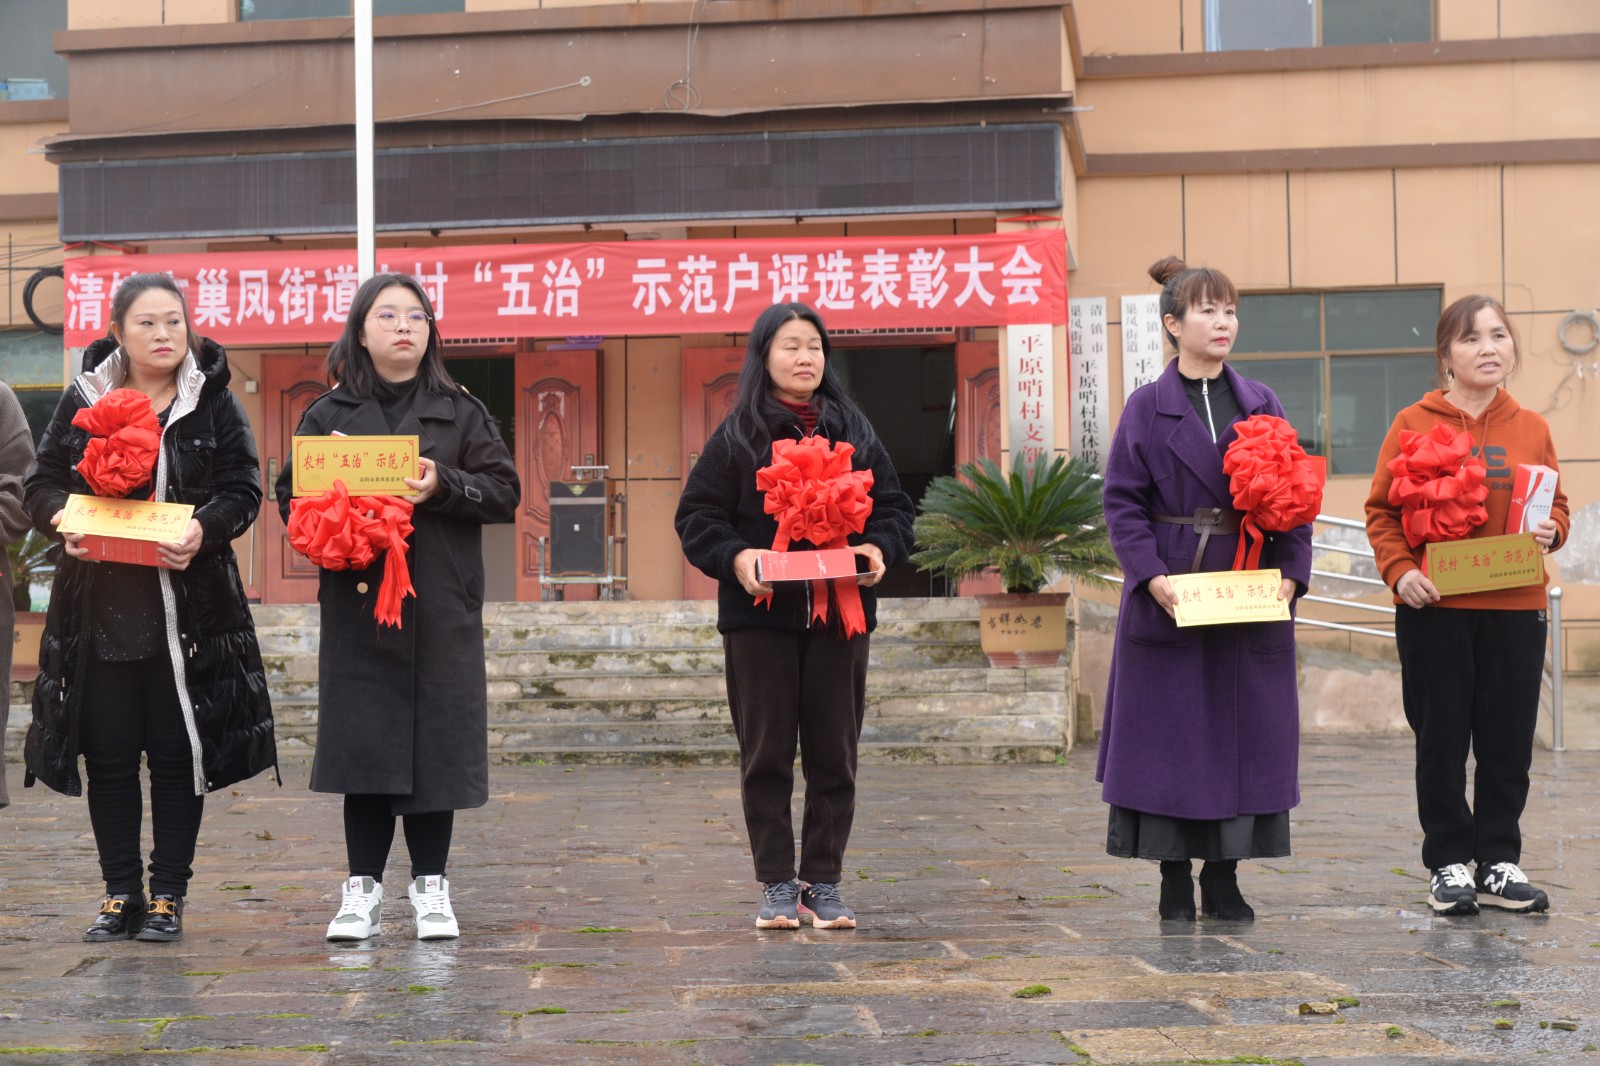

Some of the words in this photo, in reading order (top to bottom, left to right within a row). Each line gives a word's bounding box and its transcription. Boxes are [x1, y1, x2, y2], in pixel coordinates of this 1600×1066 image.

[66, 245, 1043, 330] 清巢凤街道村“五治”示范户评选表彰大会
[303, 452, 412, 470] 农村“五治”示范户
[1437, 547, 1534, 572] 农村“五治”示范户
